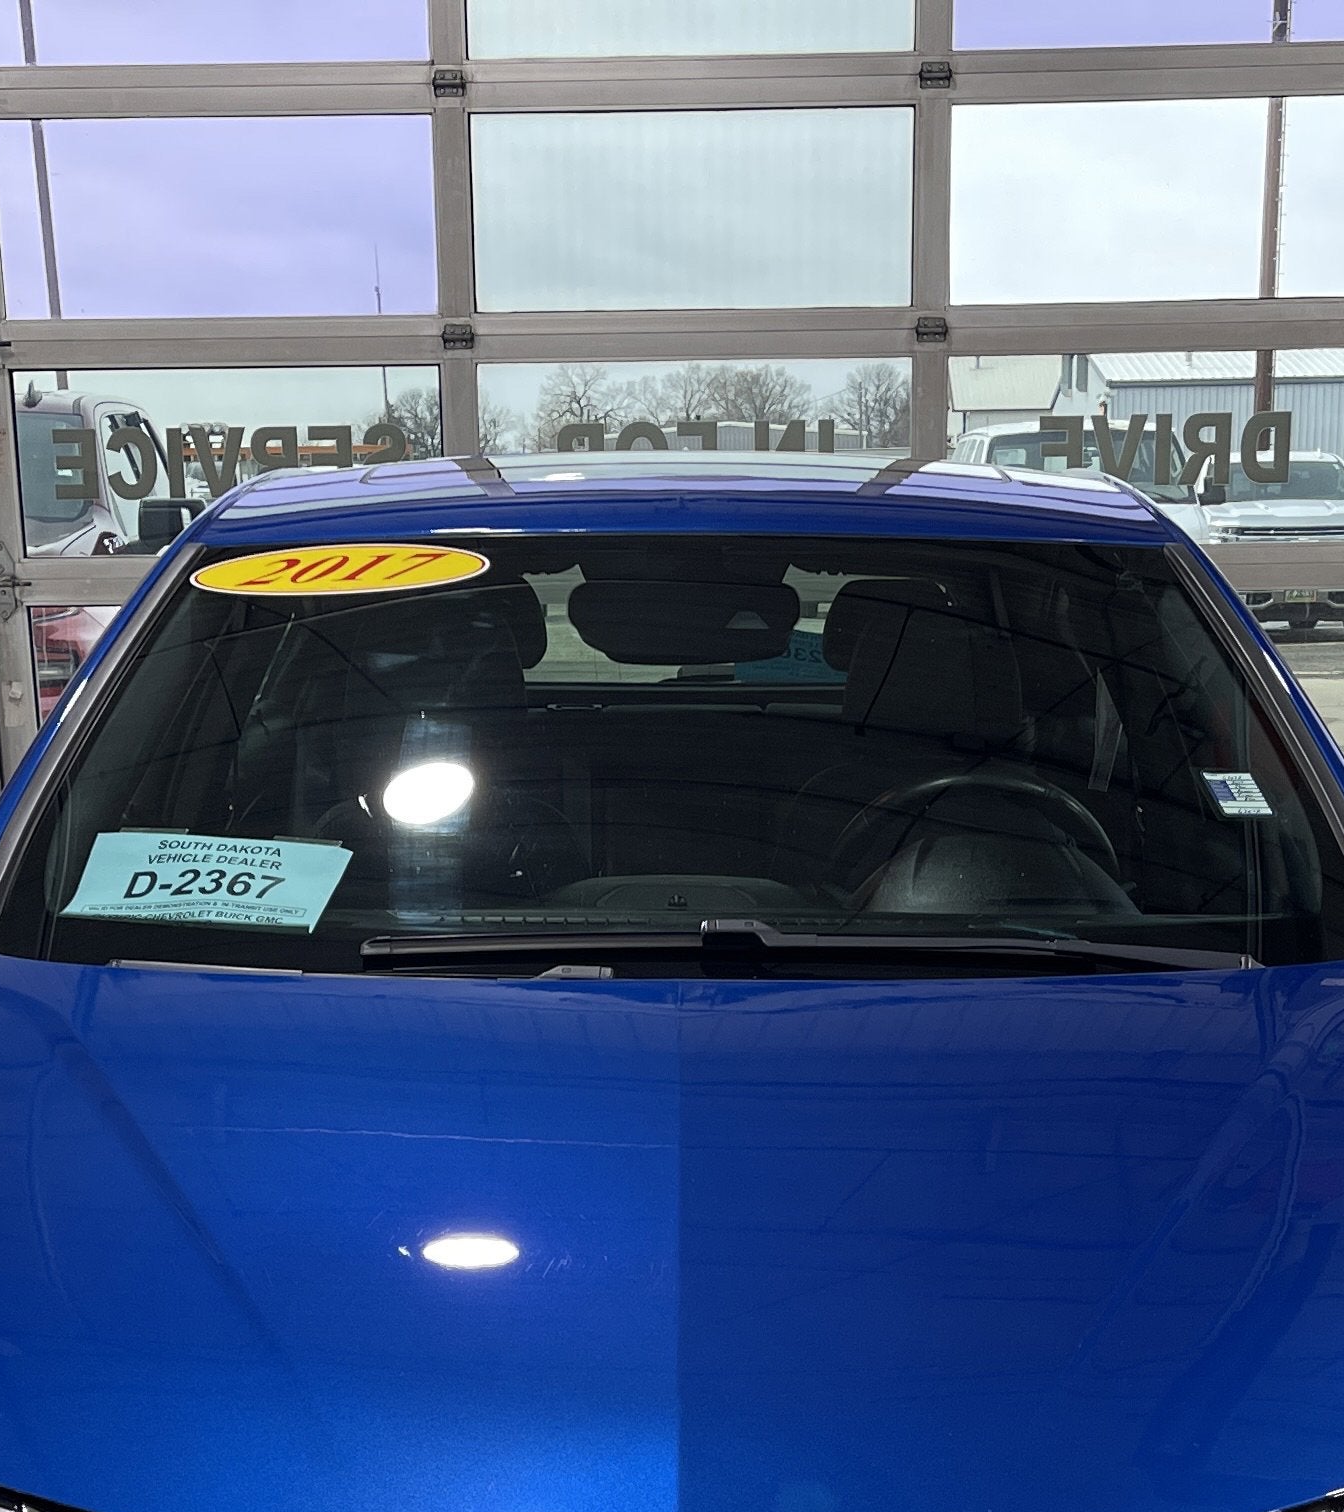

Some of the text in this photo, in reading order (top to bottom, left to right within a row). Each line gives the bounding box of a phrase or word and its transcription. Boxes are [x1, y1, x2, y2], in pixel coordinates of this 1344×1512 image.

[236, 553, 451, 586] 2017
[158, 839, 282, 857] SOUTH DAKOTA
[148, 853, 283, 871] VEHICLE DEALER
[123, 868, 286, 899] D-2367
[215, 911, 252, 921] BUICK
[256, 915, 284, 925] GMC
